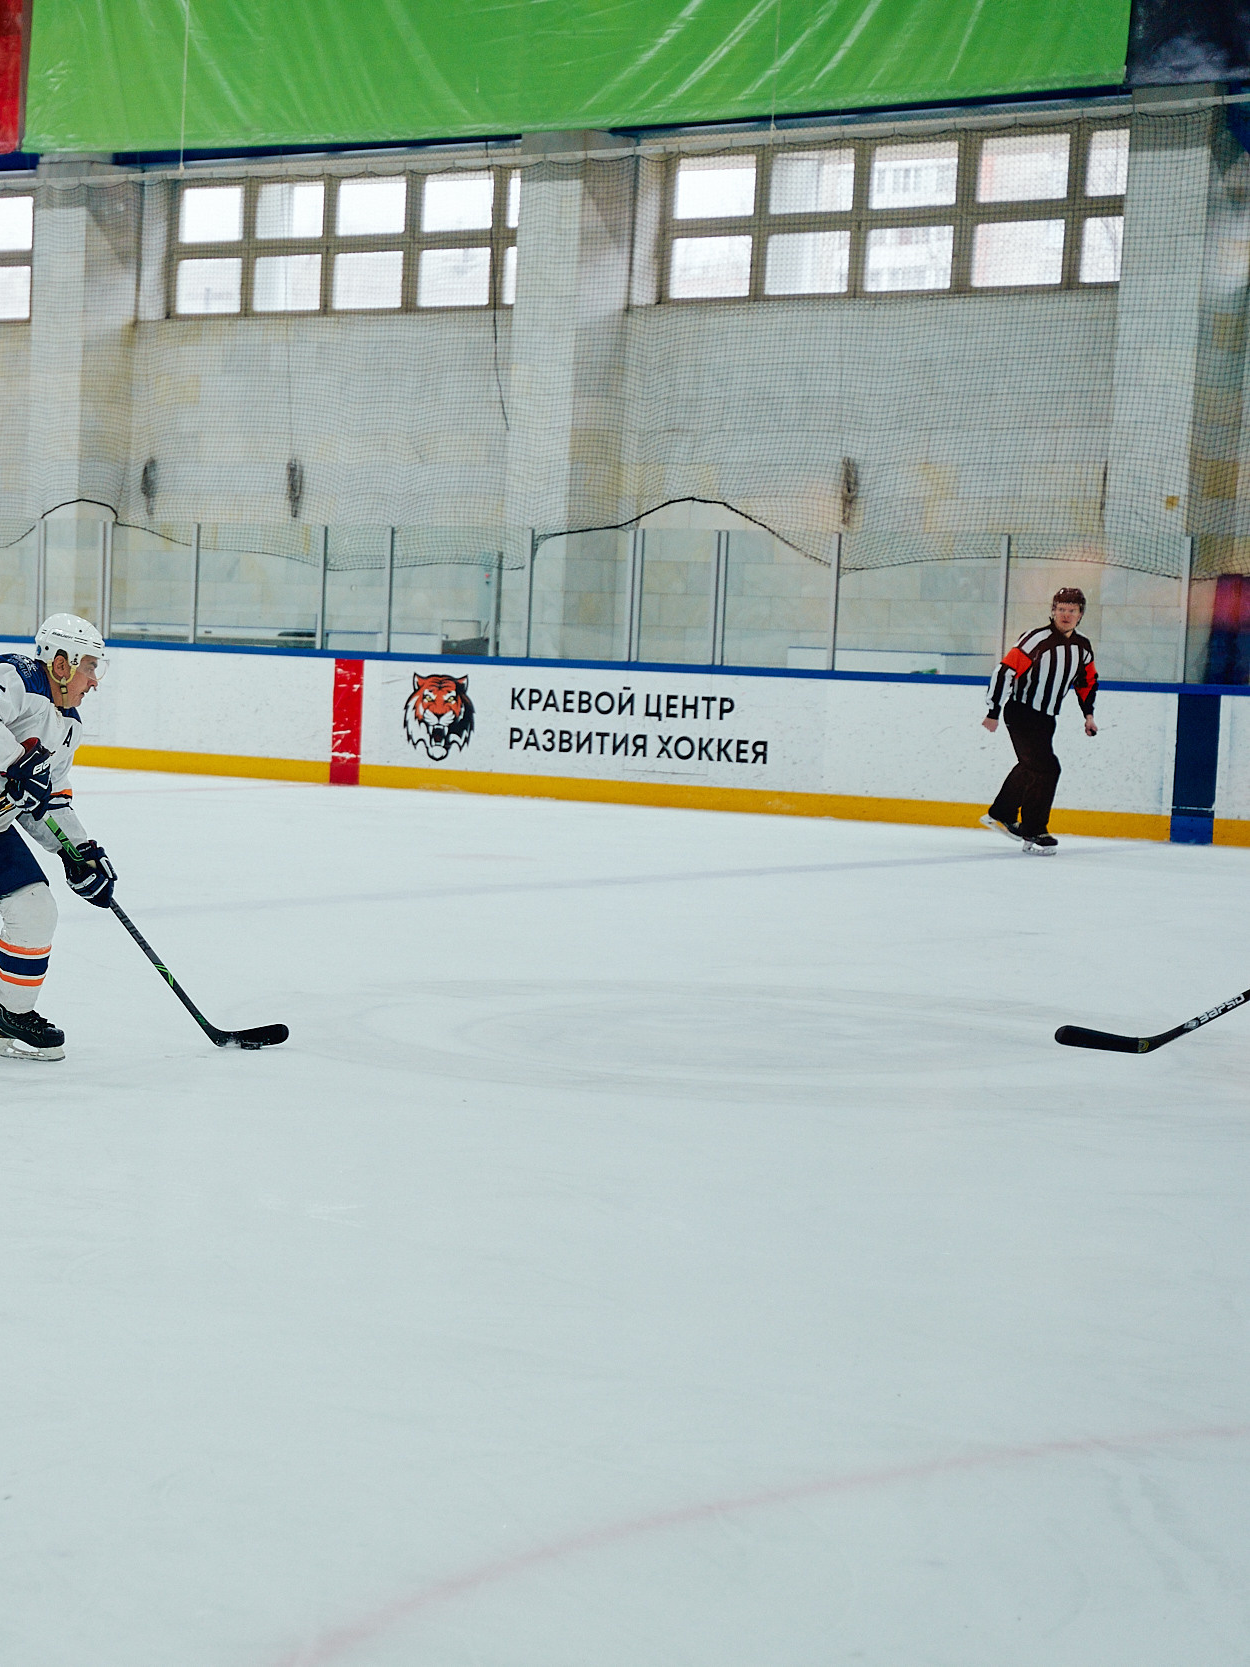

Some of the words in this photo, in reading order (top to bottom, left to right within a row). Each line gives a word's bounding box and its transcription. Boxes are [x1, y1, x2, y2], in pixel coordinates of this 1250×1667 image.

[510, 686, 635, 716] КРАЕВОЙ
[644, 693, 735, 721] ЦЕНТР
[509, 727, 647, 758] РАЗВИТИЯ
[656, 734, 769, 765] ХОККЕЯ
